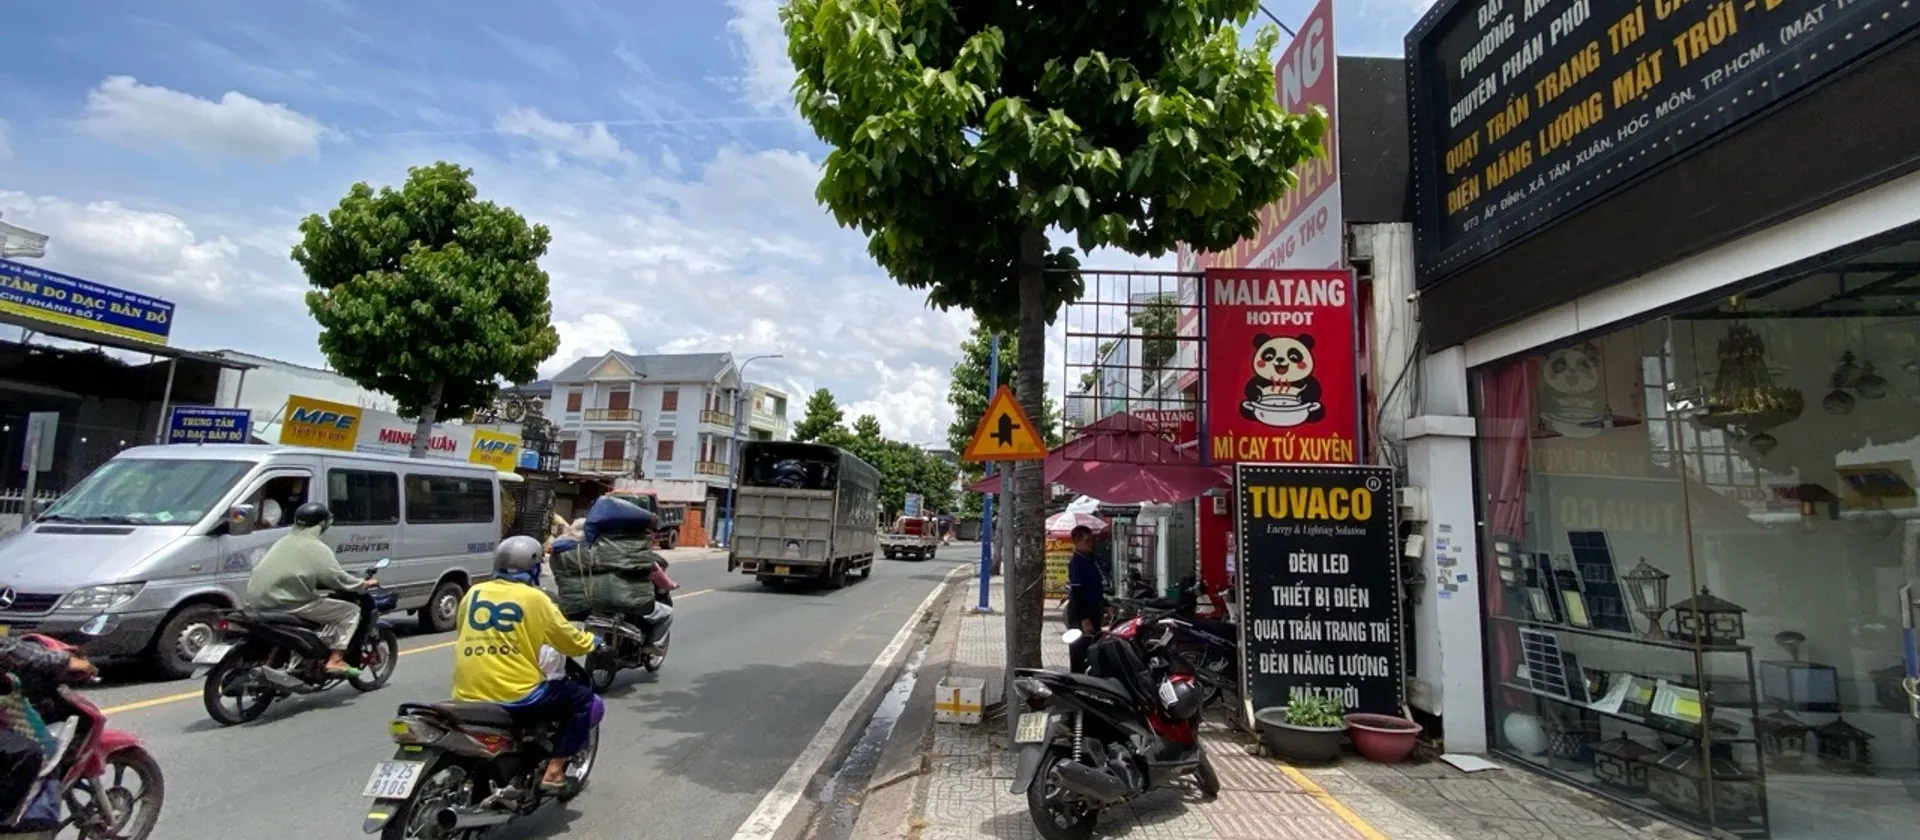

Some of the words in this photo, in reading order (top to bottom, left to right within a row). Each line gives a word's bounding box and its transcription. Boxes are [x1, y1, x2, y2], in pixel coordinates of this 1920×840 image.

[1459, 13, 1515, 80] PHƯƠNG
[1450, 72, 1497, 129] CHUYÊN
[1502, 32, 1544, 86] PHÂN
[1445, 130, 1480, 175] QUẠT
[1486, 92, 1530, 145] TRẦN
[1534, 40, 1601, 109] TRANG
[1446, 174, 1480, 216] ĐIỆN
[1486, 140, 1533, 191] NĂNG
[1538, 91, 1604, 157] LƯỢNG
[1612, 49, 1664, 110] MẶT
[1672, 1, 1738, 68] TRỜI
[1528, 174, 1546, 194] XÃ
[1548, 160, 1571, 182] TÂN
[1575, 136, 1614, 166] XUÂN,
[1617, 112, 1650, 141] HÓC
[1655, 86, 1696, 119] MÔN,
[1299, 206, 1328, 246] THỌ
[0, 275, 39, 294] TÂM
[43, 286, 67, 300] ĐO
[70, 292, 106, 309] ĐẠC
[109, 301, 142, 318] BẢN
[145, 309, 167, 324] ĐỒ
[1214, 279, 1345, 307] MALATANG
[75, 308, 93, 318] SỐ
[1246, 311, 1314, 325] HOTPOT
[289, 407, 356, 429] MPE
[379, 428, 417, 446] MINH
[428, 436, 457, 452] UÂN
[476, 438, 518, 455] MPE
[1214, 429, 1234, 459] MÌ
[1239, 437, 1268, 460] CAY
[1272, 431, 1296, 460] TỨ
[1300, 432, 1353, 462] XUYÊN
[1248, 486, 1372, 521] TUVACO
[336, 542, 390, 554] SPRINTER
[1289, 548, 1319, 573] ĐÈN
[1322, 553, 1349, 574] LED
[468, 590, 524, 632] be
[1272, 579, 1311, 607] THIẾT
[1315, 587, 1330, 612] BỊ
[1334, 583, 1369, 613] ĐIỆN
[1254, 619, 1285, 644] QUẠT
[1289, 613, 1321, 640] TRẦN
[1325, 621, 1367, 642] TRANG
[1369, 618, 1390, 642] TRÍ
[1260, 649, 1288, 674] ĐÈN
[1293, 650, 1335, 675] NĂNG
[1339, 654, 1389, 681] LƯỢNG
